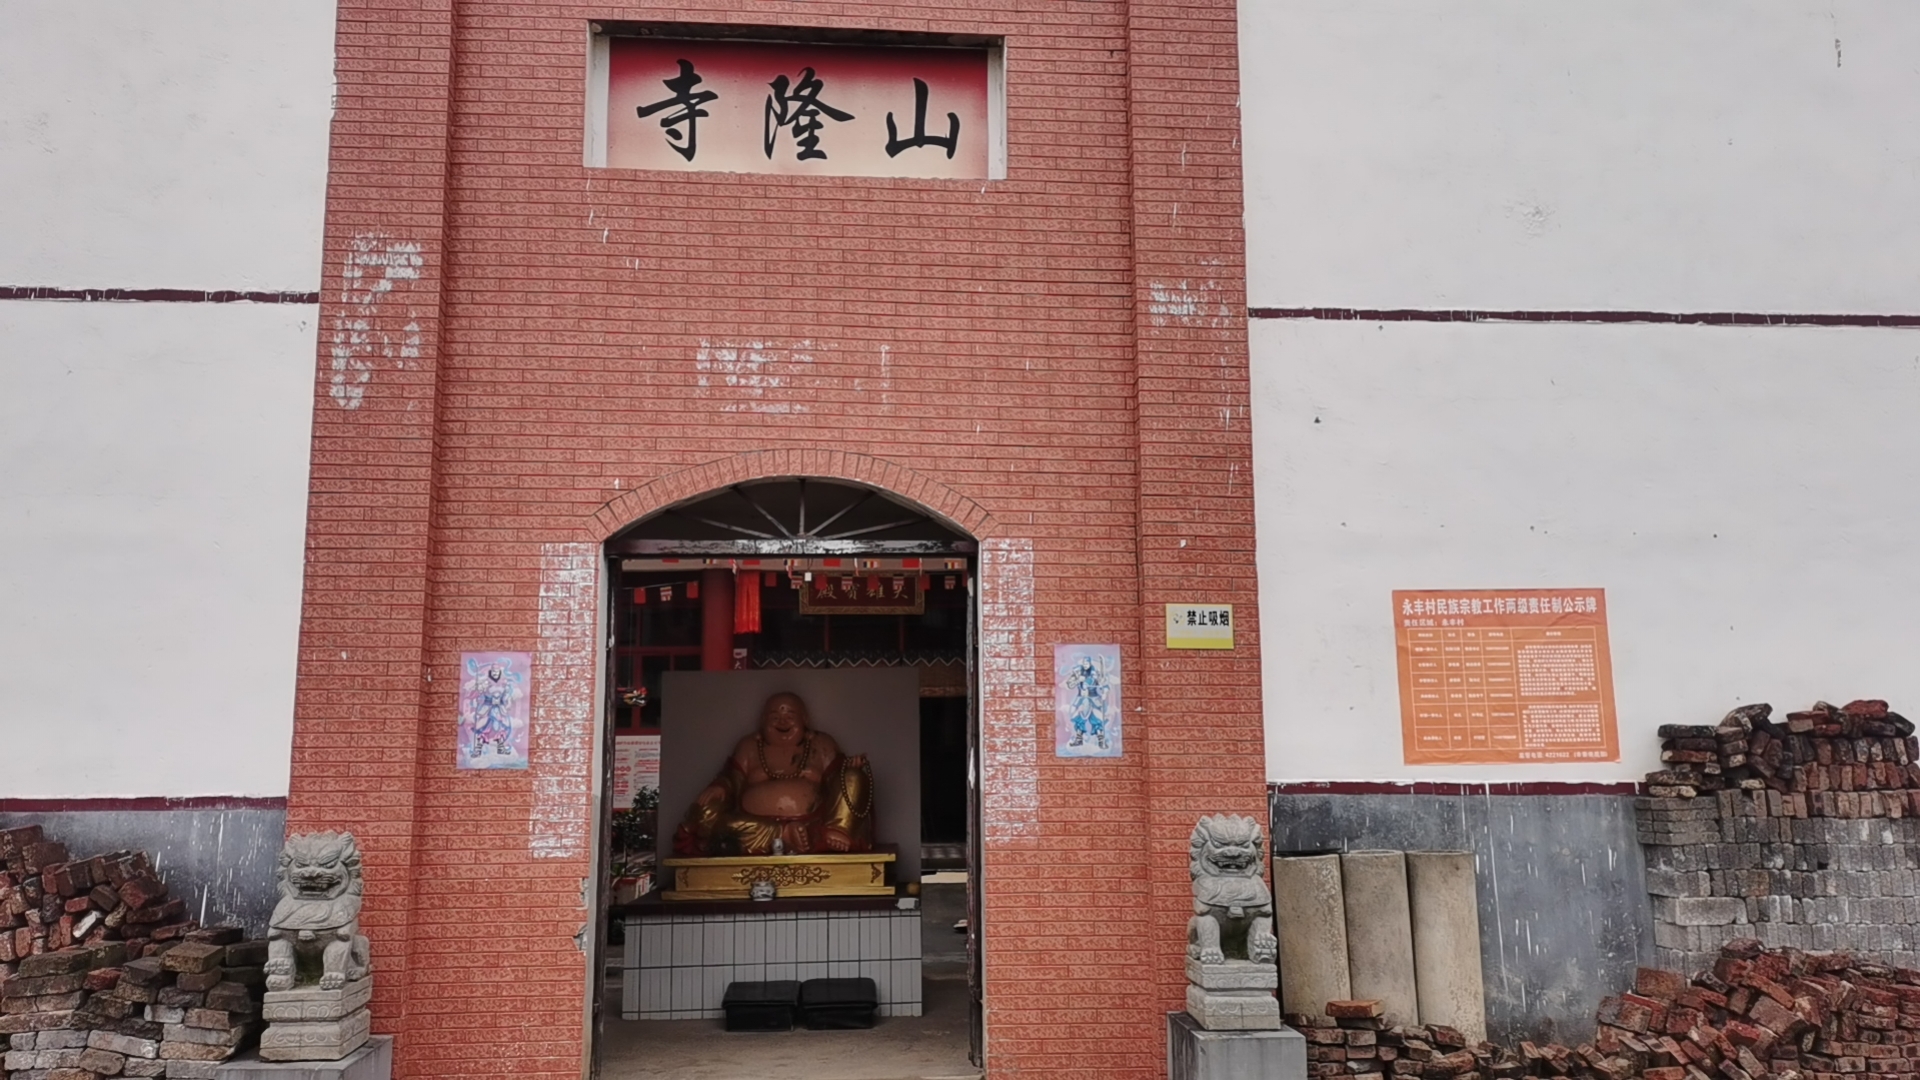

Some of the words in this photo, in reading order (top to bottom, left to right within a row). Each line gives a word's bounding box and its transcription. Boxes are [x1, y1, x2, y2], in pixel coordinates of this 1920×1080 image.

[1402, 596, 1598, 616] 永丰村民族宗教工作两级责任制公示牌
[1187, 609, 1230, 627] 禁止吸烟
